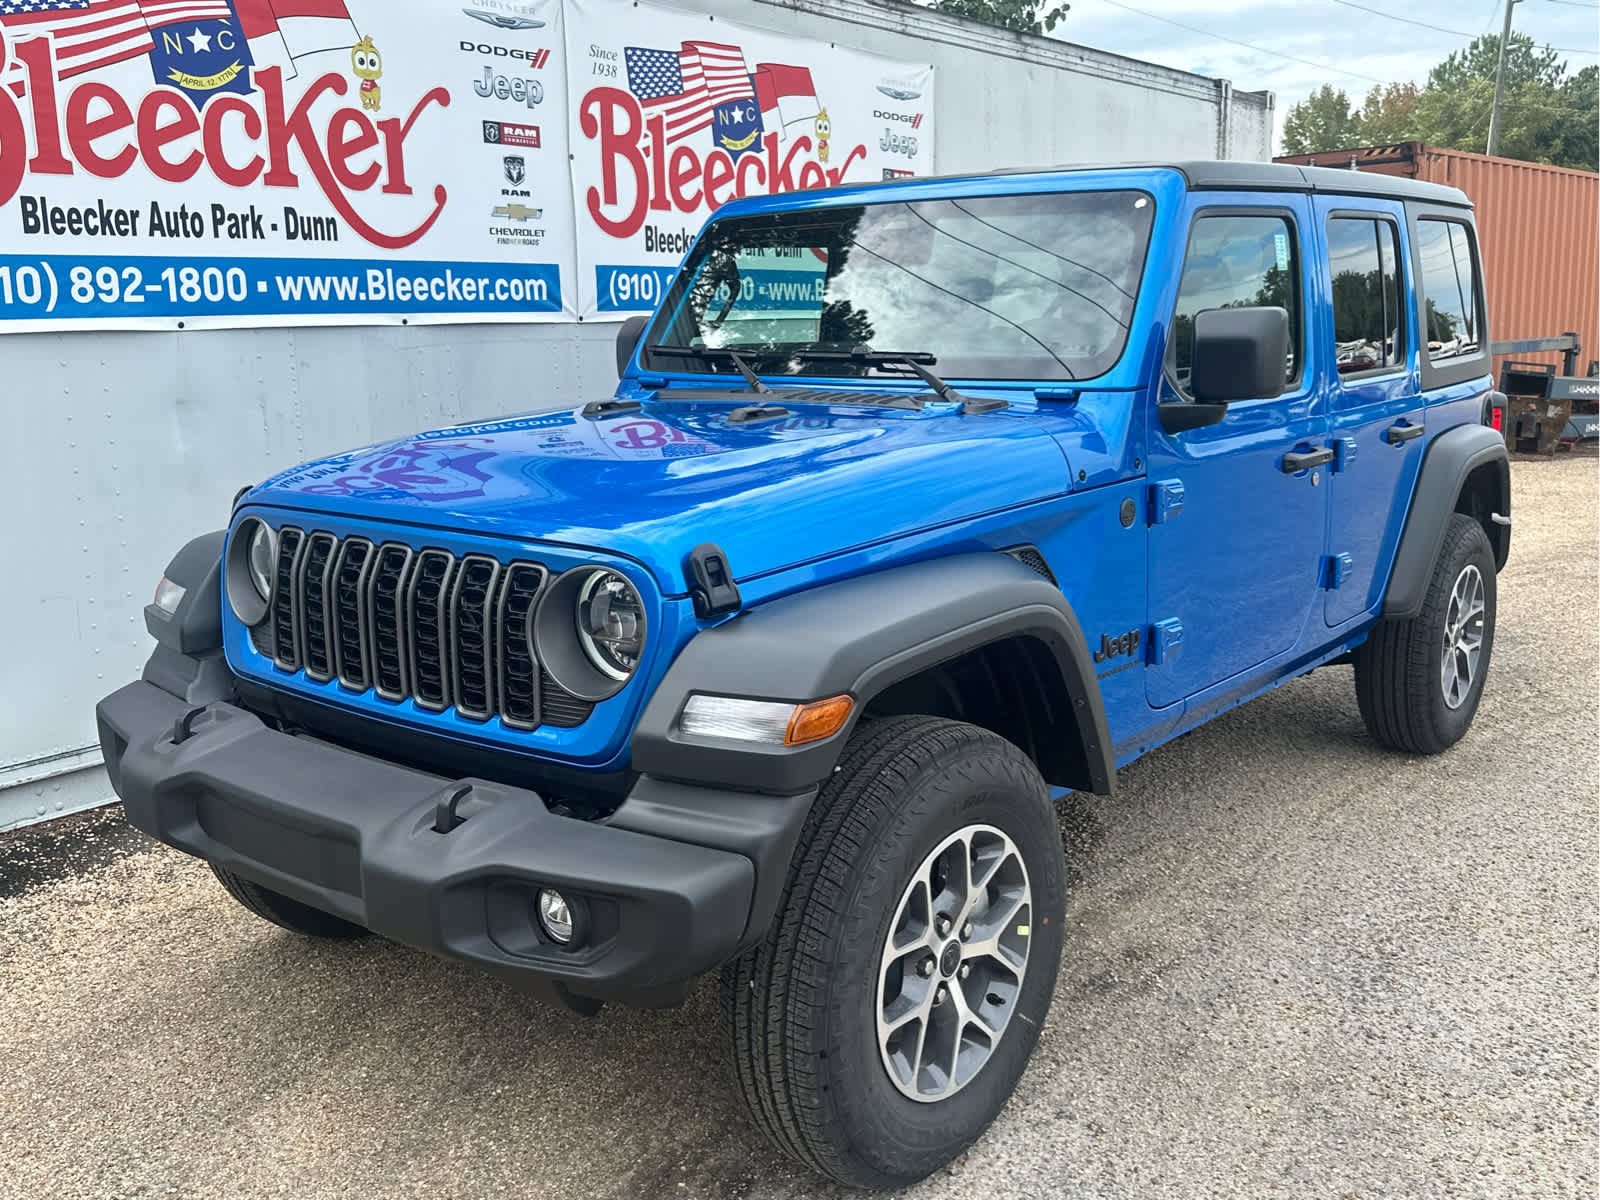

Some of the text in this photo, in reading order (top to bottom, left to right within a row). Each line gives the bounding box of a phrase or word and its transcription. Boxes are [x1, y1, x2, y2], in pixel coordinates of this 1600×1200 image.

[460, 41, 539, 62] DODGE
[589, 43, 618, 61] Since
[592, 62, 618, 78] 1938
[182, 77, 205, 88] APRIL
[473, 65, 544, 109] Jeep
[873, 109, 916, 123] DODGE
[0, 25, 450, 249] leecker
[503, 126, 537, 138] RAM
[879, 127, 919, 159] Jeep
[501, 188, 531, 197] RAM
[19, 195, 339, 241] Bleecker Auto Park Dunn
[489, 227, 545, 238] CHEVROLET
[69, 266, 248, 304] 892-1800
[275, 267, 548, 302] www.Bleecker.com
[609, 269, 661, 307] (910)
[1093, 629, 1141, 664] Jeep
